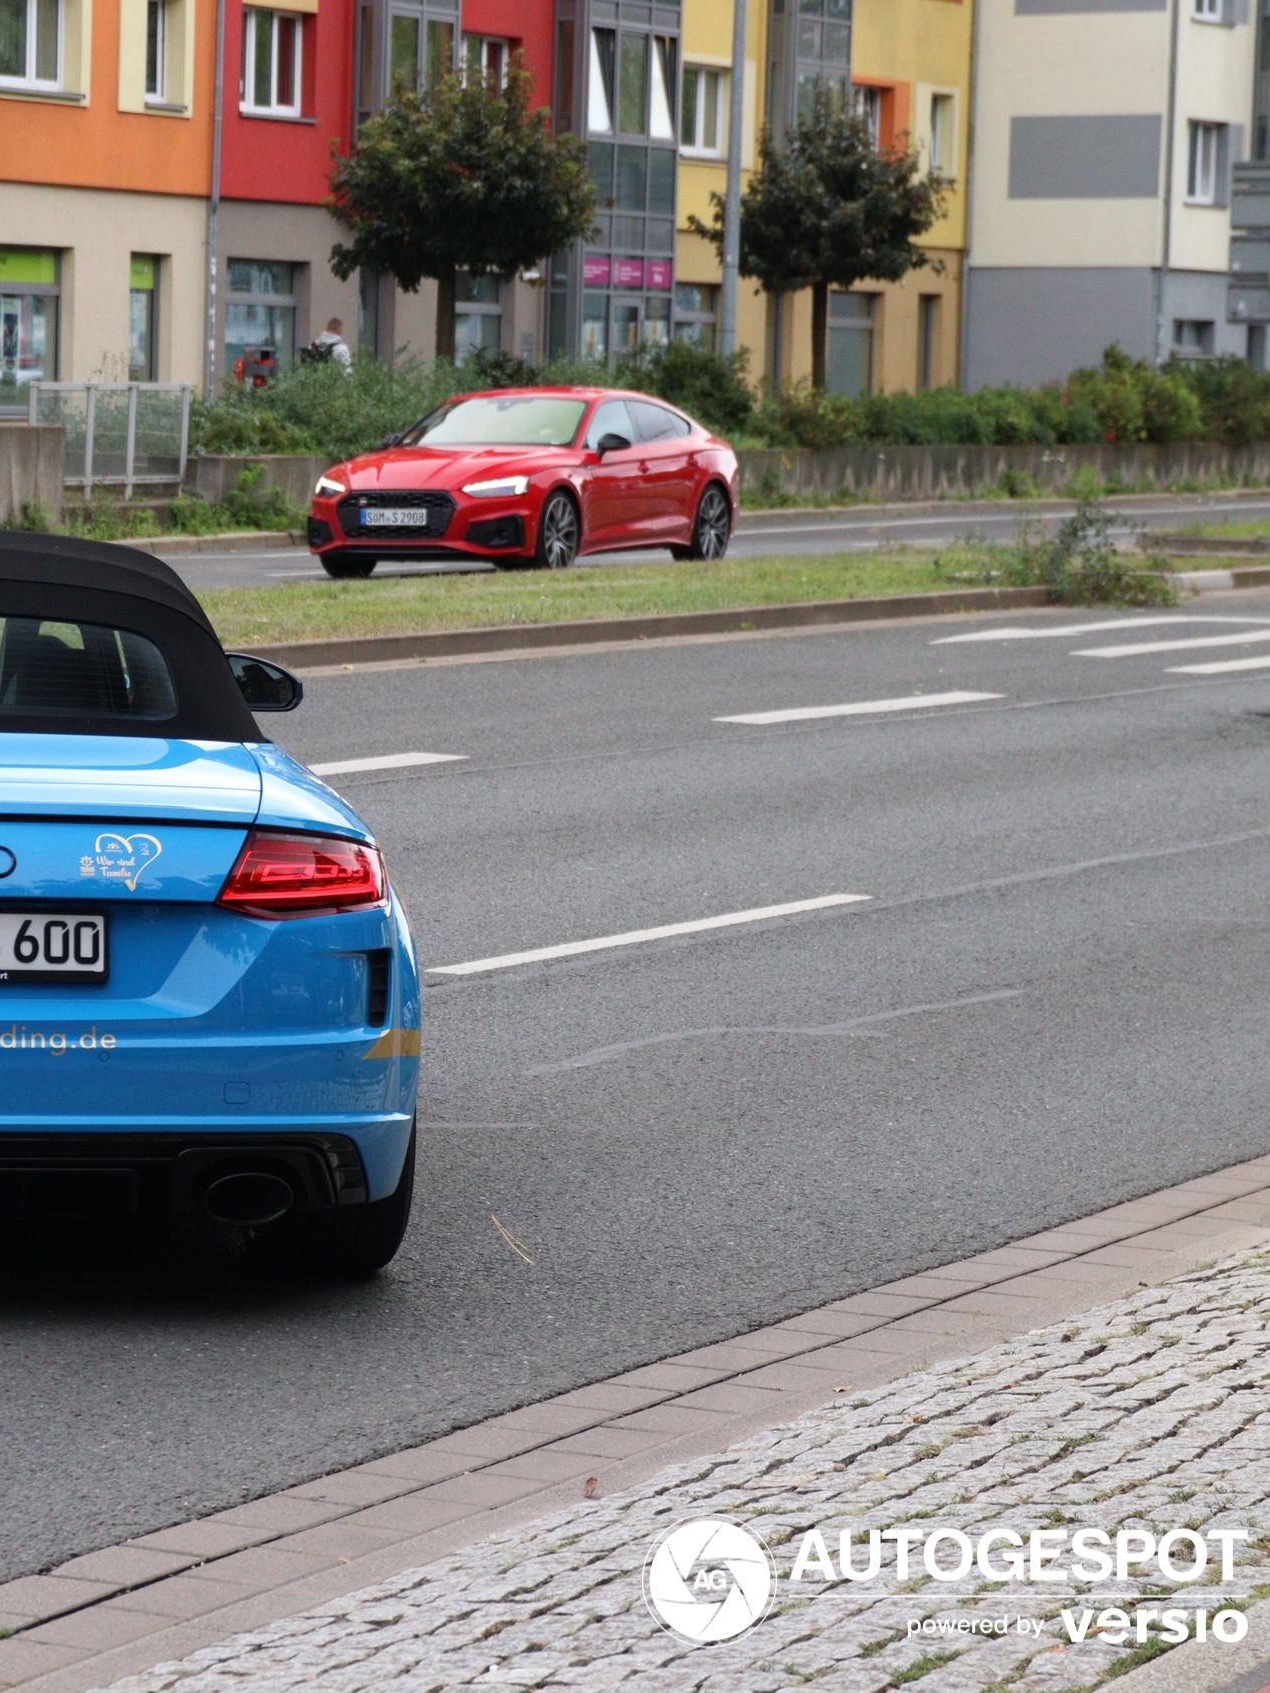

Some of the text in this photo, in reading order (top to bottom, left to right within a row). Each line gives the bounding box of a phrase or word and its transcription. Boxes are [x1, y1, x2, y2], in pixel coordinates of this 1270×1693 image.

[401, 512, 424, 524] 2908
[96, 855, 136, 866] Wir sind
[13, 919, 100, 965] 600
